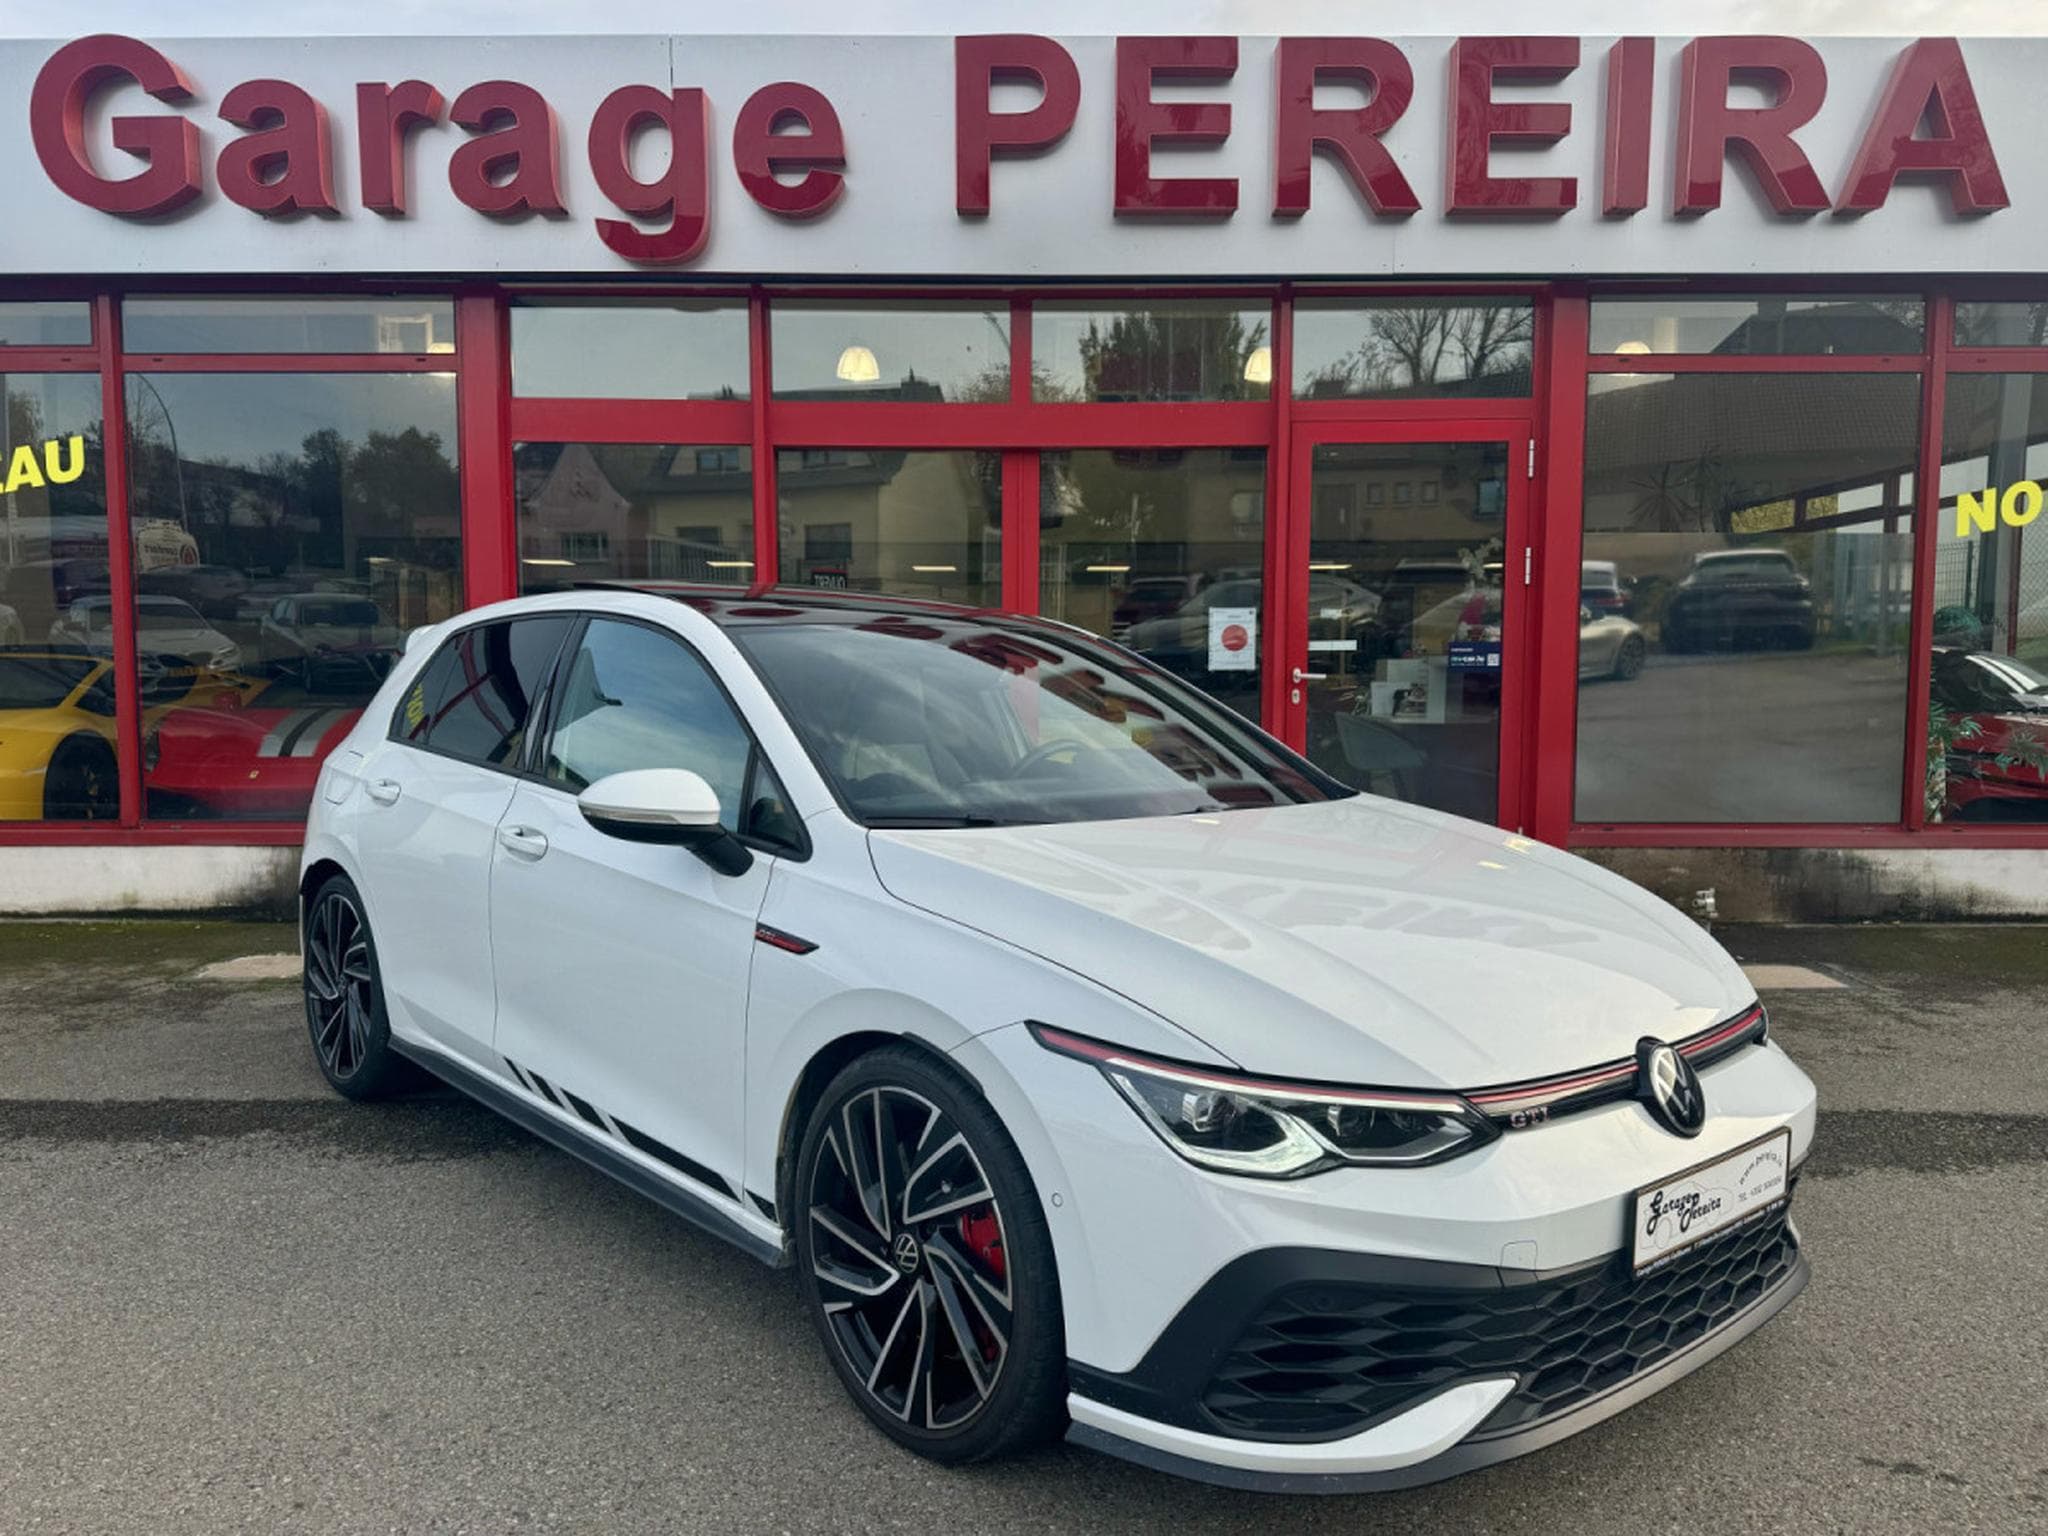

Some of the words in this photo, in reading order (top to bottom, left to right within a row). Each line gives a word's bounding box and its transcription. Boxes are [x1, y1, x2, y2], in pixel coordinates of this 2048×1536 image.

[30, 34, 847, 263] Garage
[954, 34, 2010, 217] PEREIRA
[1646, 1189, 1693, 1237] Garage
